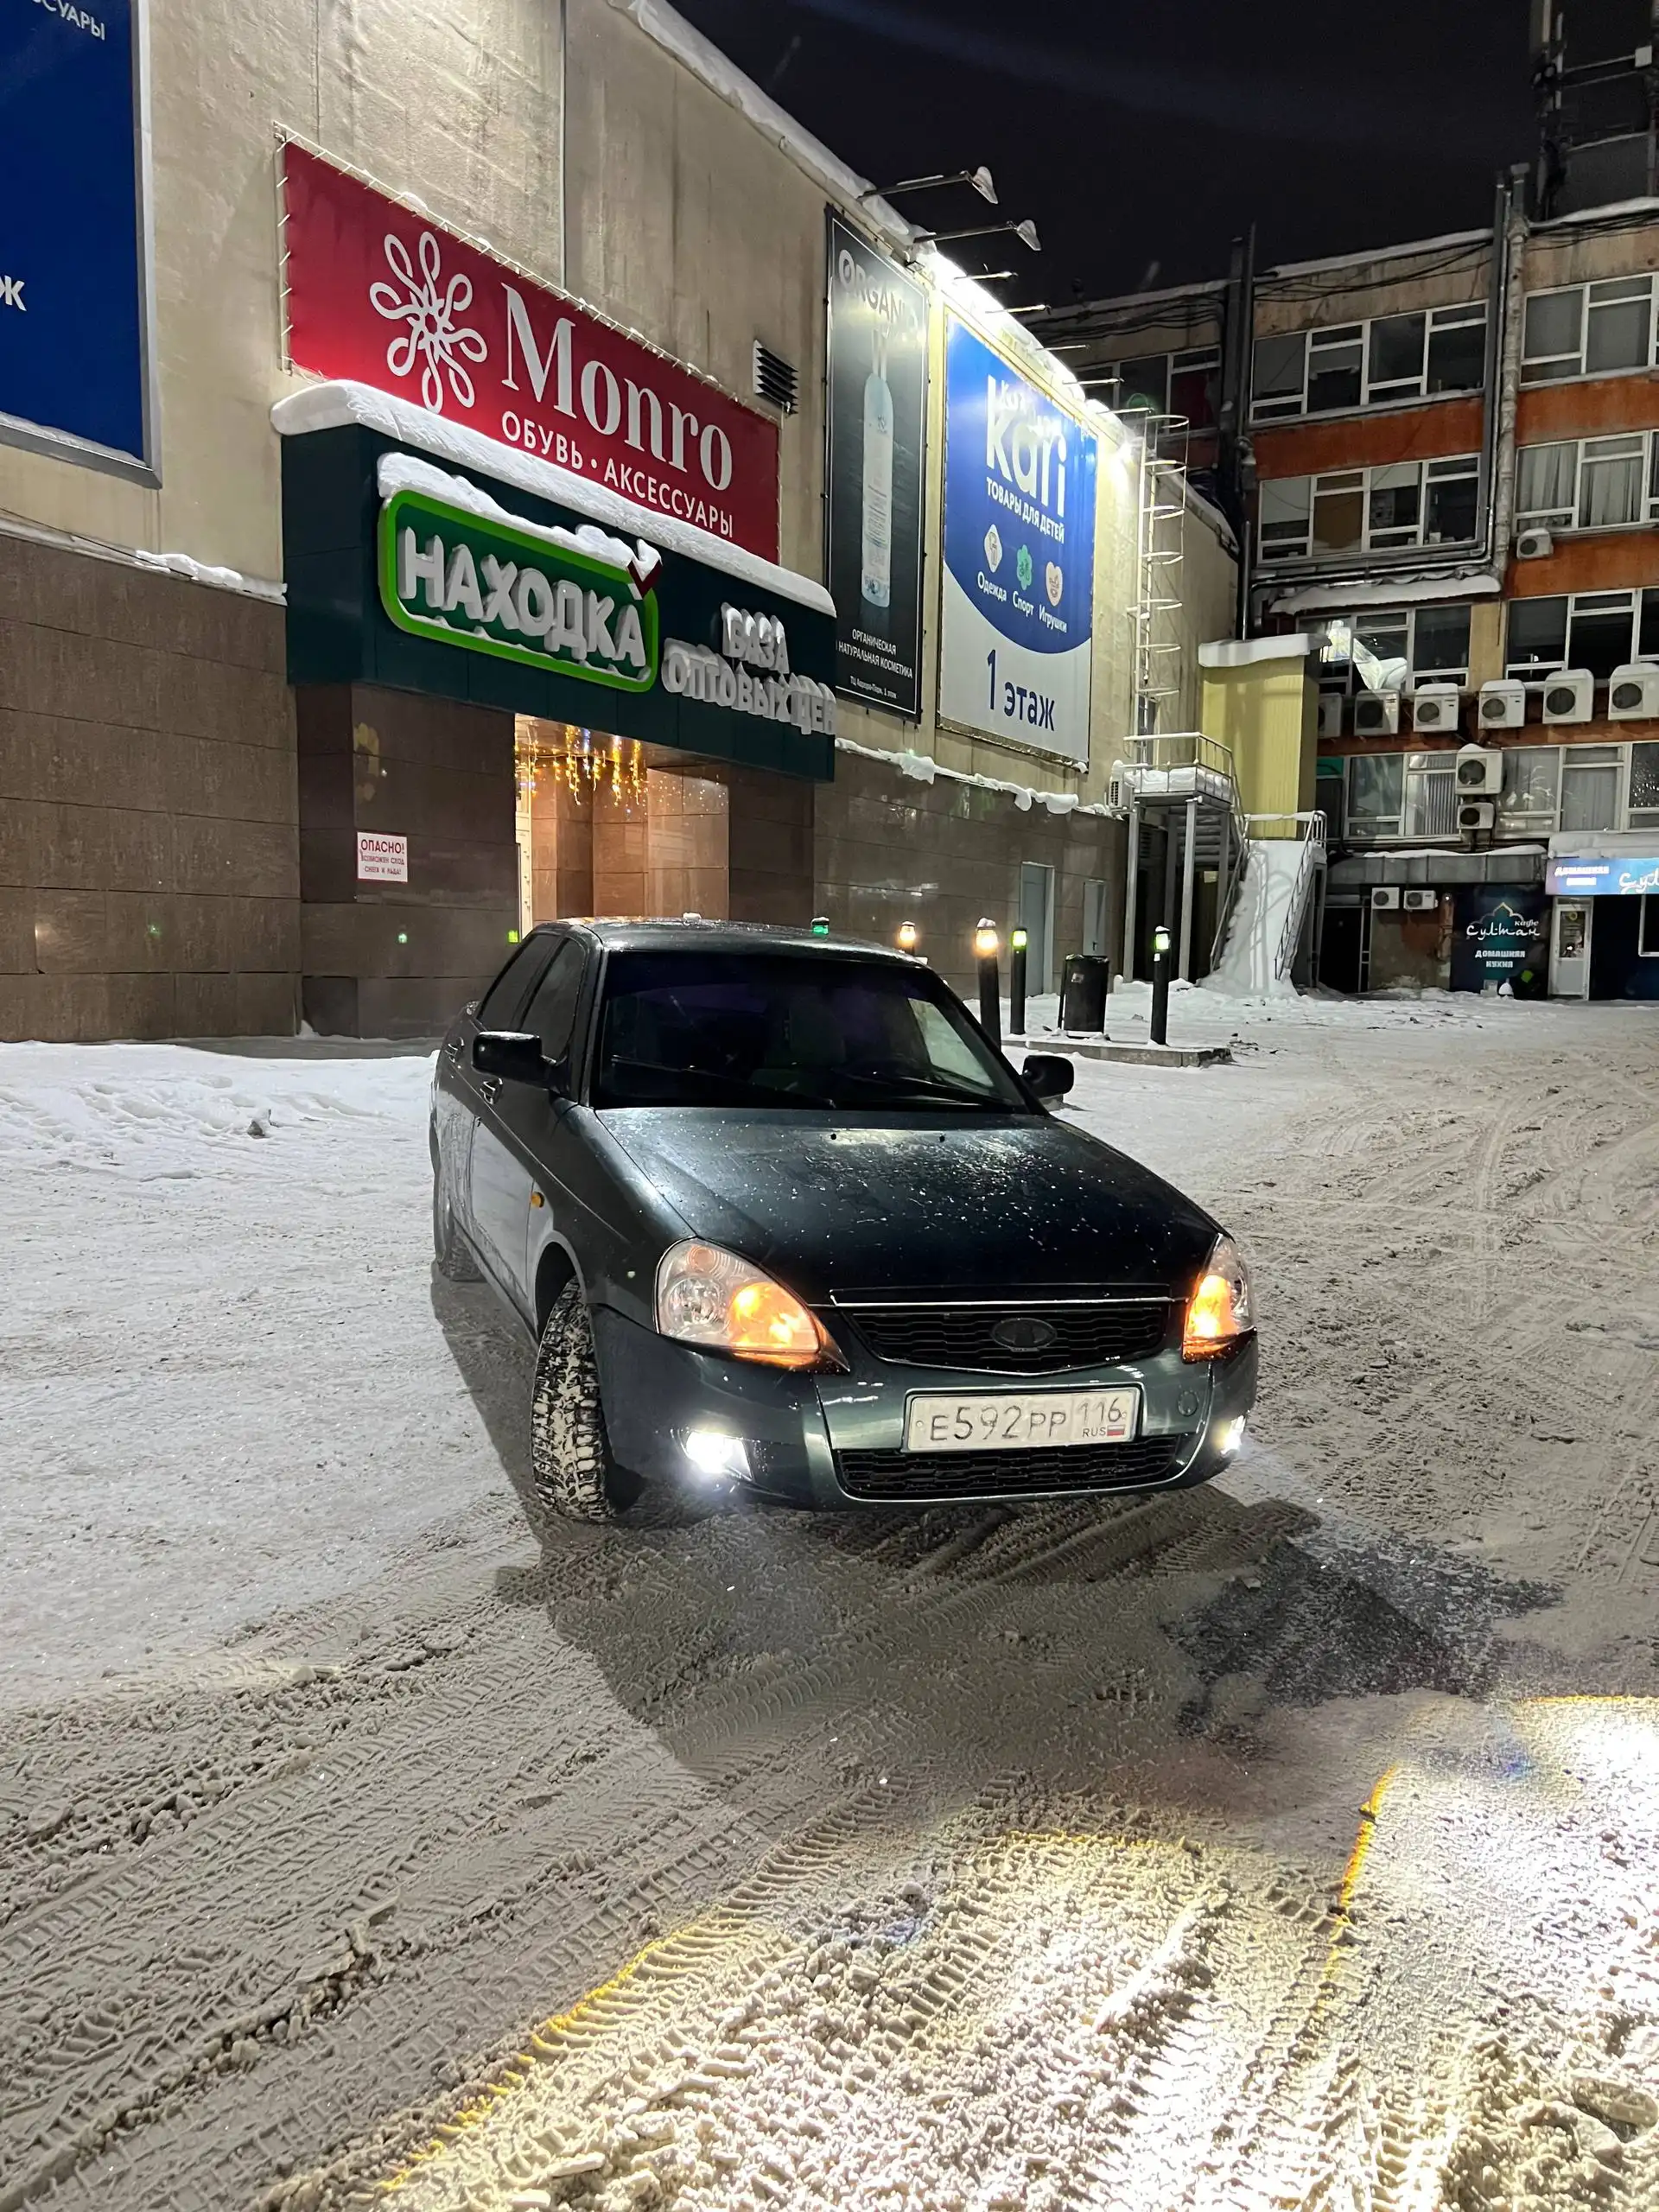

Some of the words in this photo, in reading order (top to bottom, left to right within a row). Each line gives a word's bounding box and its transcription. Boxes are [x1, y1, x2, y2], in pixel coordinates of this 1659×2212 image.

[33, 0, 105, 41] СУАРЫ
[501, 283, 732, 490] Monro
[502, 410, 583, 469] ОБУВЬ
[603, 457, 733, 537] АКСЕССУАРЫ
[986, 476, 1021, 516] ТОВАРЫ
[1022, 501, 1039, 527] ДЛЯ
[1039, 516, 1065, 544] ДЕТЕЙ
[397, 526, 646, 668] НАХОДКА
[977, 571, 1007, 602] Одежда
[1013, 590, 1033, 617] Спорт
[1039, 604, 1067, 633] Игрушки
[721, 603, 789, 674] БАЗА
[838, 640, 880, 666] НАТУРАЛЬНАЯ
[880, 657, 912, 678] КОСМЕТИКА
[852, 628, 897, 655] ОРГАНИЧЕСКАЯ
[661, 641, 791, 722] ОПТОВЫХ
[788, 677, 836, 734] ЦЕН
[987, 649, 995, 710] 1
[1004, 682, 1054, 731] этаж
[360, 839, 404, 854] ОПАСНО!
[1466, 922, 1541, 940] Султан
[1079, 1398, 1122, 1424] 116
[1082, 1427, 1106, 1438] RUS
